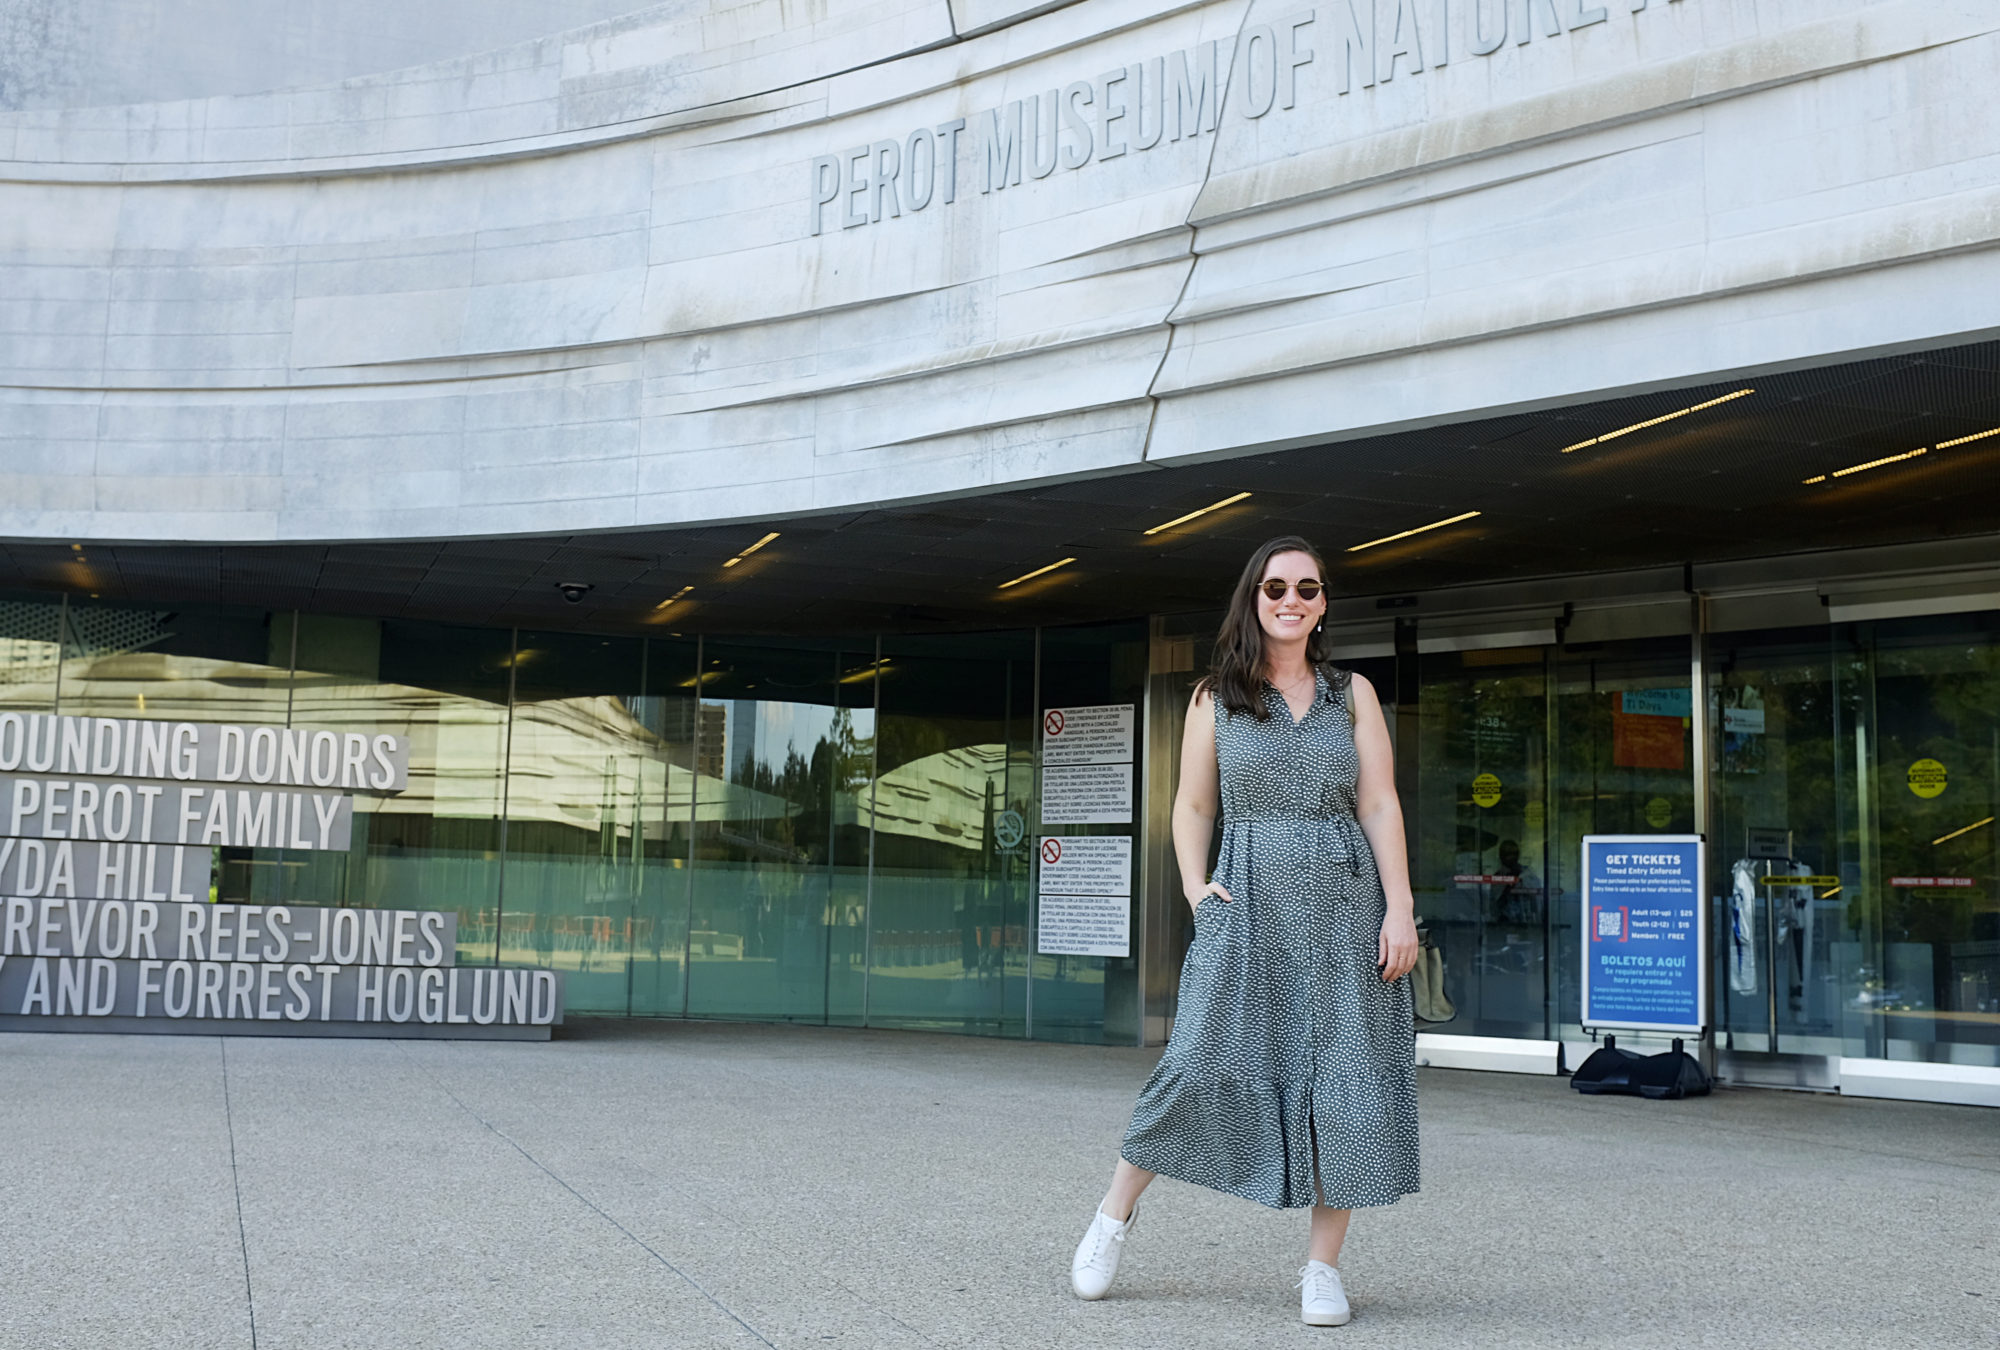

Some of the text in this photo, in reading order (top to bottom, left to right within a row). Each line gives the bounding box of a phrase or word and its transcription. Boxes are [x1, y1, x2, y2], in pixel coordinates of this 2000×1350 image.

[810, 118, 966, 237] PEROT
[980, 40, 1217, 194] MUSEUM
[1241, 9, 1315, 120] OF
[217, 725, 398, 791] DONORS
[10, 779, 344, 851] PEROT FAMILY
[96, 842, 194, 902] HILL
[1606, 855, 1681, 865] GET TICKETS
[1606, 867, 1681, 876] Timed Entry Enforced
[178, 902, 444, 967] REES-JONES
[1601, 955, 1686, 967] BOLETOS AQUÍ
[20, 957, 557, 1025] AND FORREST HOGLUND
